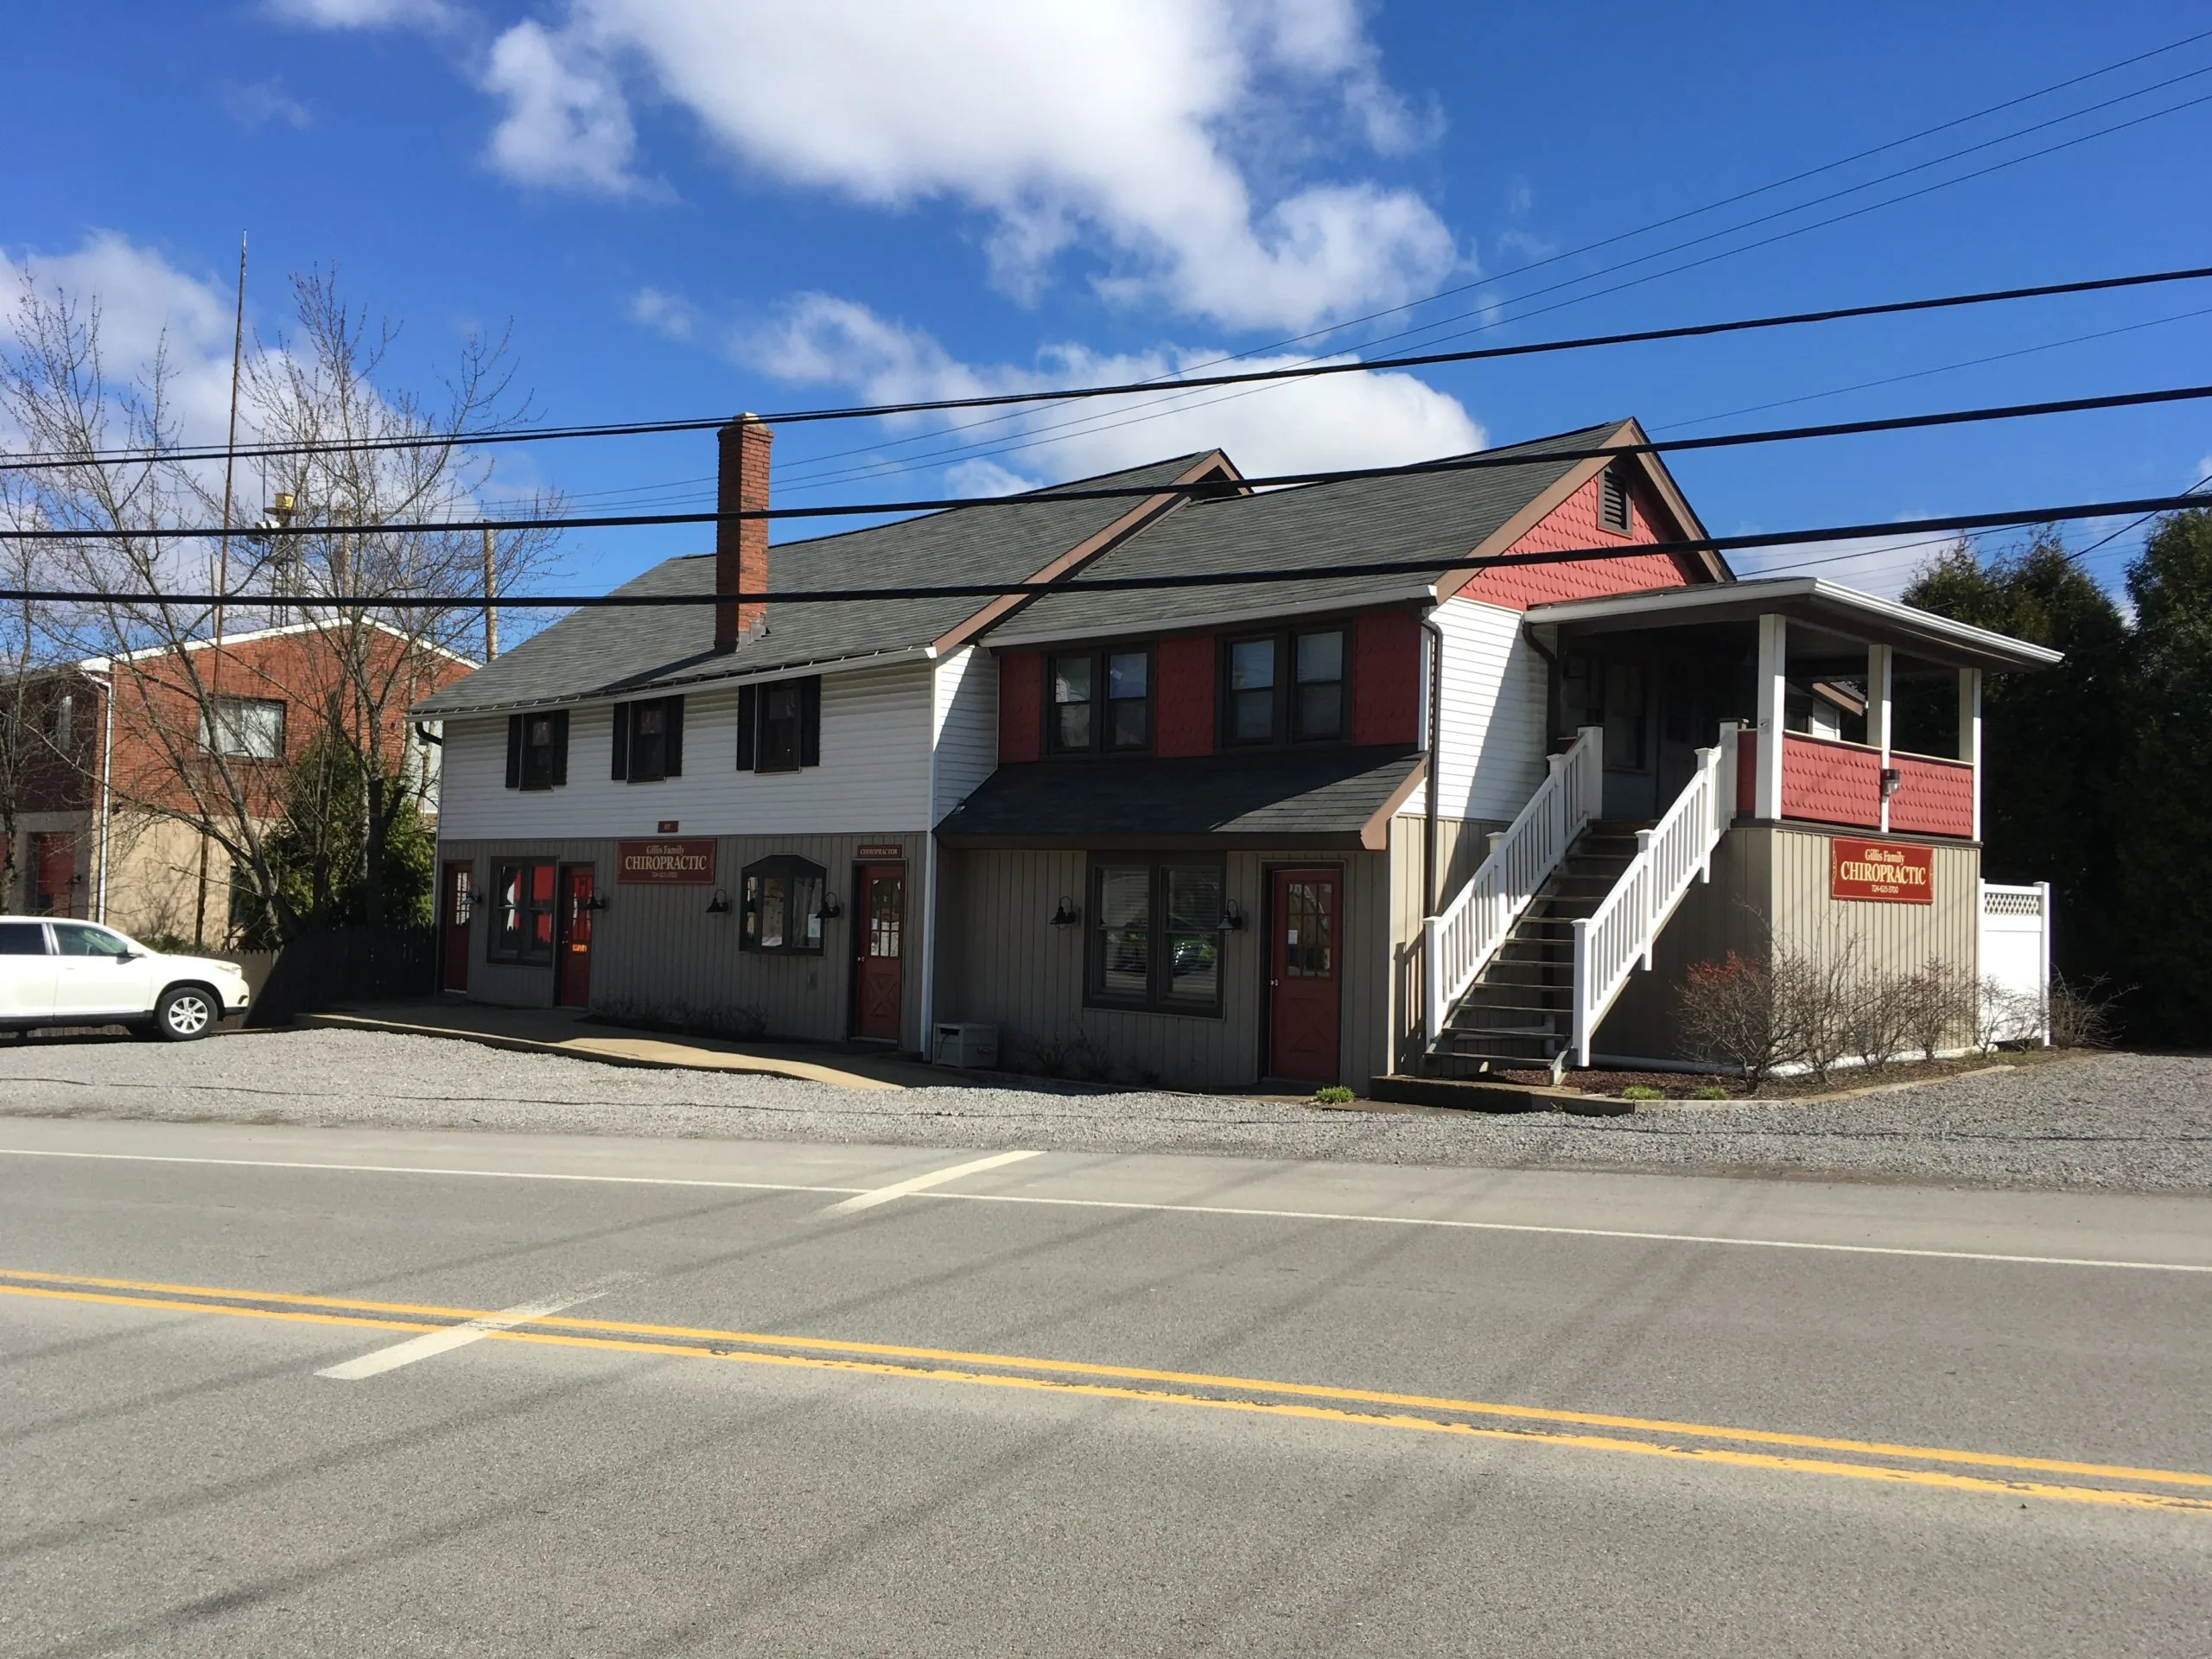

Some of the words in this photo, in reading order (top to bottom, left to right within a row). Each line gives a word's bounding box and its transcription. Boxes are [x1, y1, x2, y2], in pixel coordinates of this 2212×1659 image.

[664, 844, 685, 856] Family
[1865, 848, 1883, 861] Gillis
[1884, 850, 1905, 866] Family
[625, 855, 707, 871] CHIROPRACTIC
[1840, 861, 1926, 886] CHIROPRACTIC
